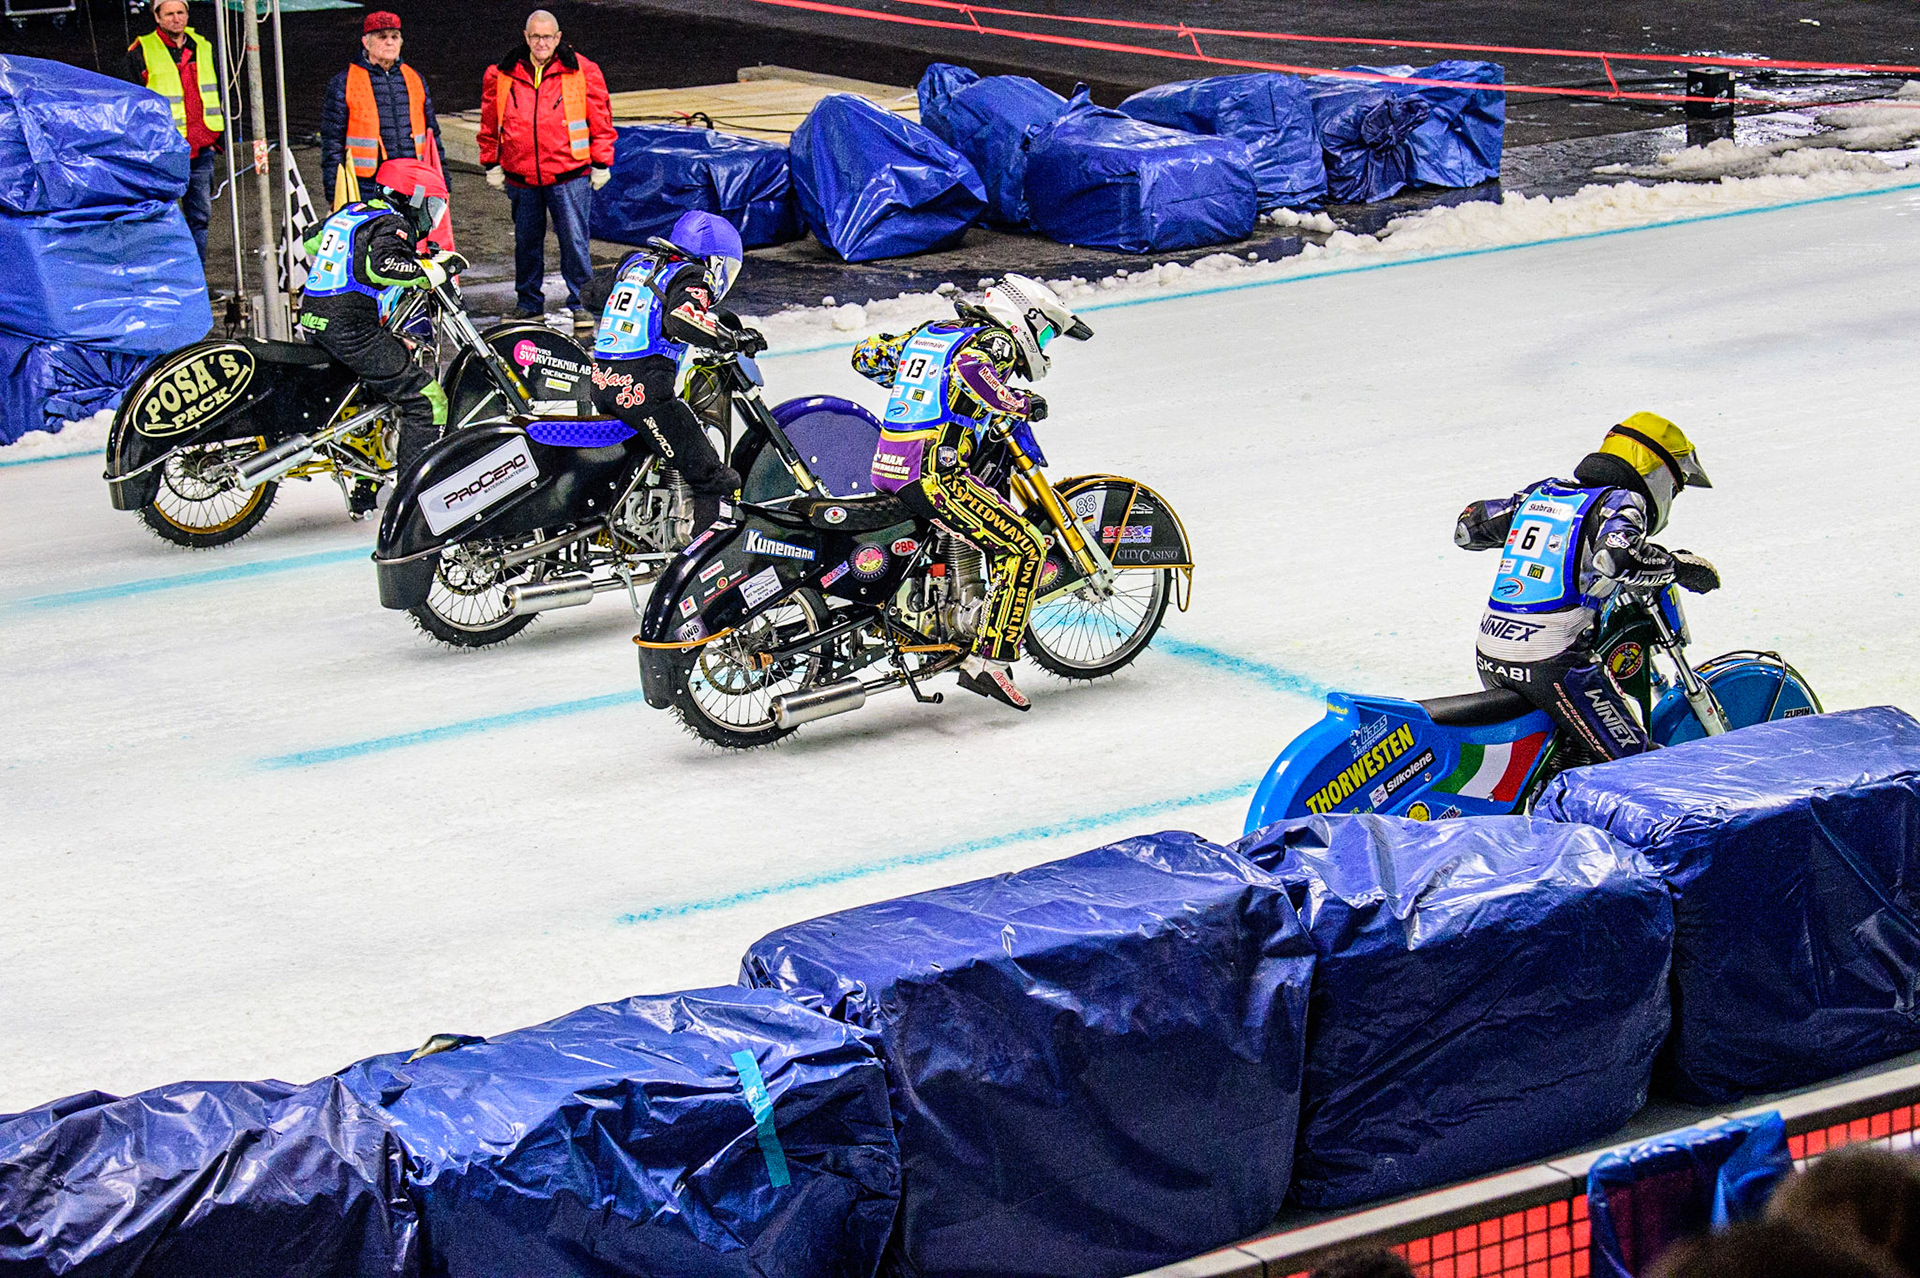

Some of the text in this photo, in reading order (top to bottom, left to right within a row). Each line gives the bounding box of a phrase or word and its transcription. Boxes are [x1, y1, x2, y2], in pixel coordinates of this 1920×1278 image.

[322, 234, 334, 251] 3
[614, 291, 632, 312] 12
[519, 351, 592, 375] SVARVTEKNIK AB
[906, 358, 926, 378] 13
[145, 354, 240, 423] POSA'S
[980, 367, 999, 389] Mauer
[172, 386, 232, 429] PACK
[616, 383, 645, 408] #58
[881, 454, 906, 466] MAX
[1076, 494, 1096, 516] 88
[746, 531, 813, 559] Kunemann
[894, 541, 916, 554] PBR
[1521, 526, 1540, 550] 6
[1117, 549, 1140, 559] CITY
[1005, 587, 1028, 643] BERLIN
[1584, 688, 1640, 748] WINTEX
[1785, 707, 1810, 718] ZUPIN
[1305, 722, 1416, 814] THORWESTEN
[1386, 752, 1433, 792] Silkolene
